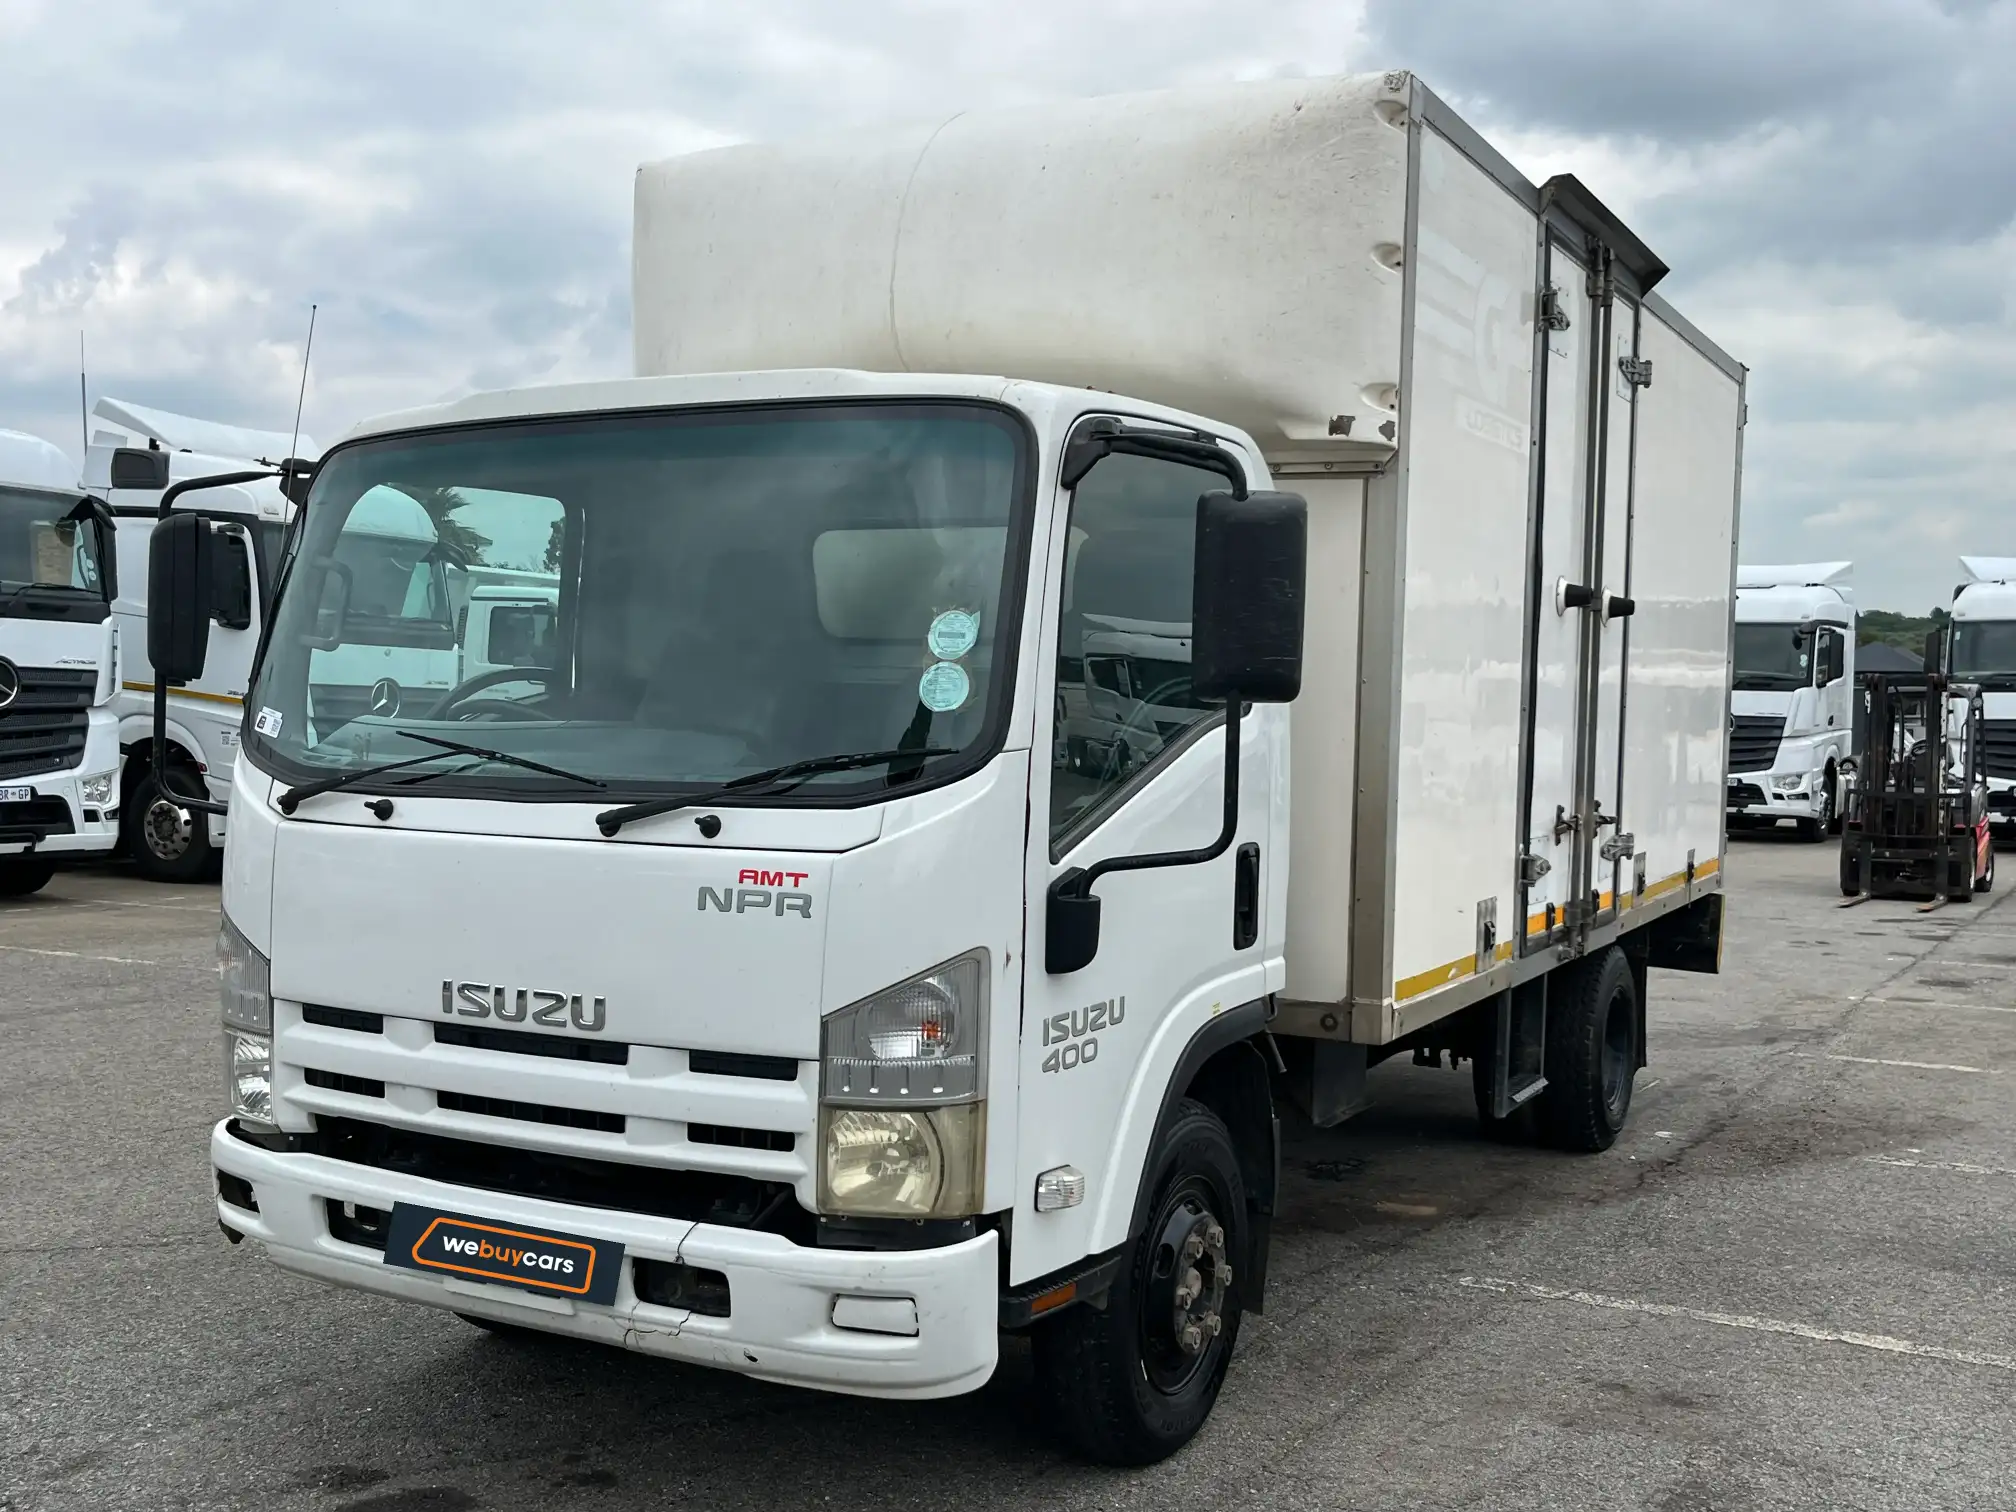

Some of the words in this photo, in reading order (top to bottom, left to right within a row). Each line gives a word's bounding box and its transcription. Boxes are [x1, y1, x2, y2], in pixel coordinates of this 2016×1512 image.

[18, 788, 30, 800] GP
[738, 869, 809, 888] AMT
[697, 886, 812, 919] NPR
[441, 978, 607, 1032] ISUZU
[1042, 995, 1126, 1047] ISUZU
[1041, 1037, 1098, 1074] 400
